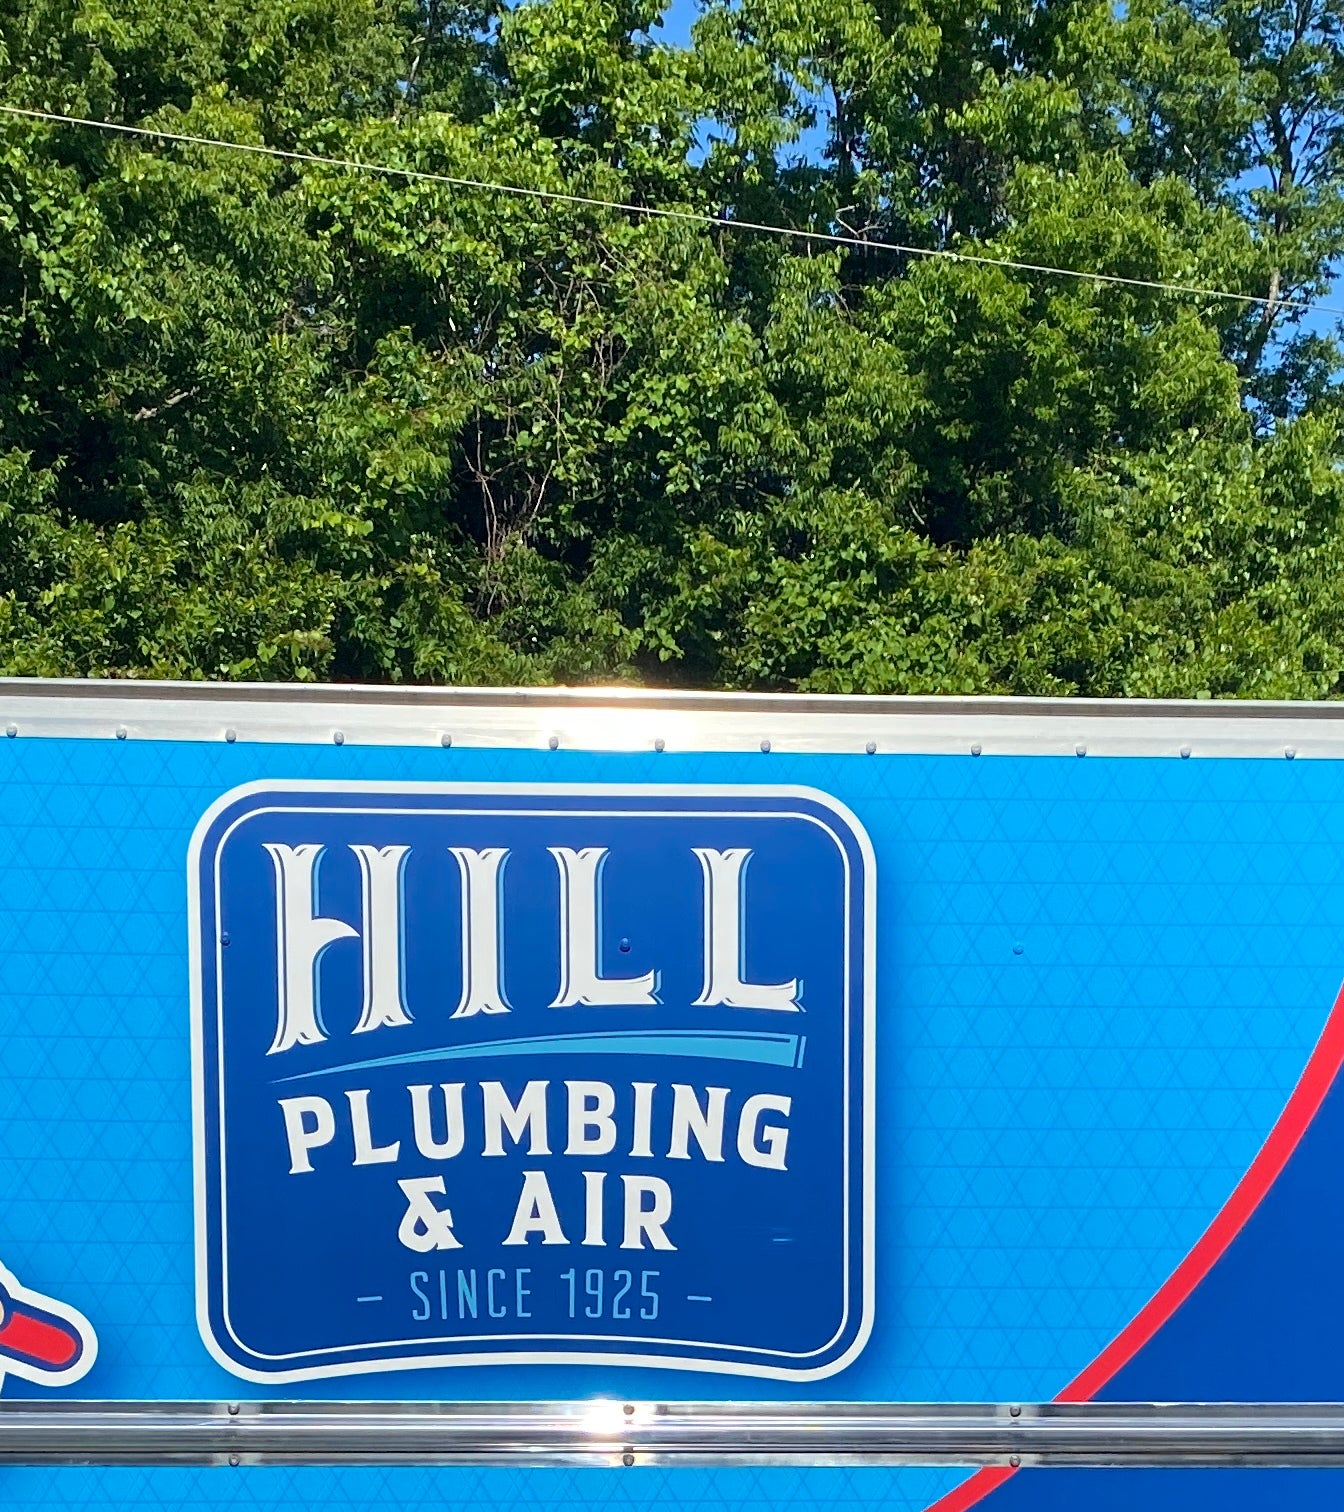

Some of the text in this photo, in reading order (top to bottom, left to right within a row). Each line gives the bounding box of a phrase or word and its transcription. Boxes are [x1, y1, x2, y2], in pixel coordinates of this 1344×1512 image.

[261, 843, 806, 1056] HILL
[277, 1080, 793, 1175] PLUMBING
[397, 1170, 678, 1253] & AIR
[410, 1268, 660, 1321] SINCE 1925
